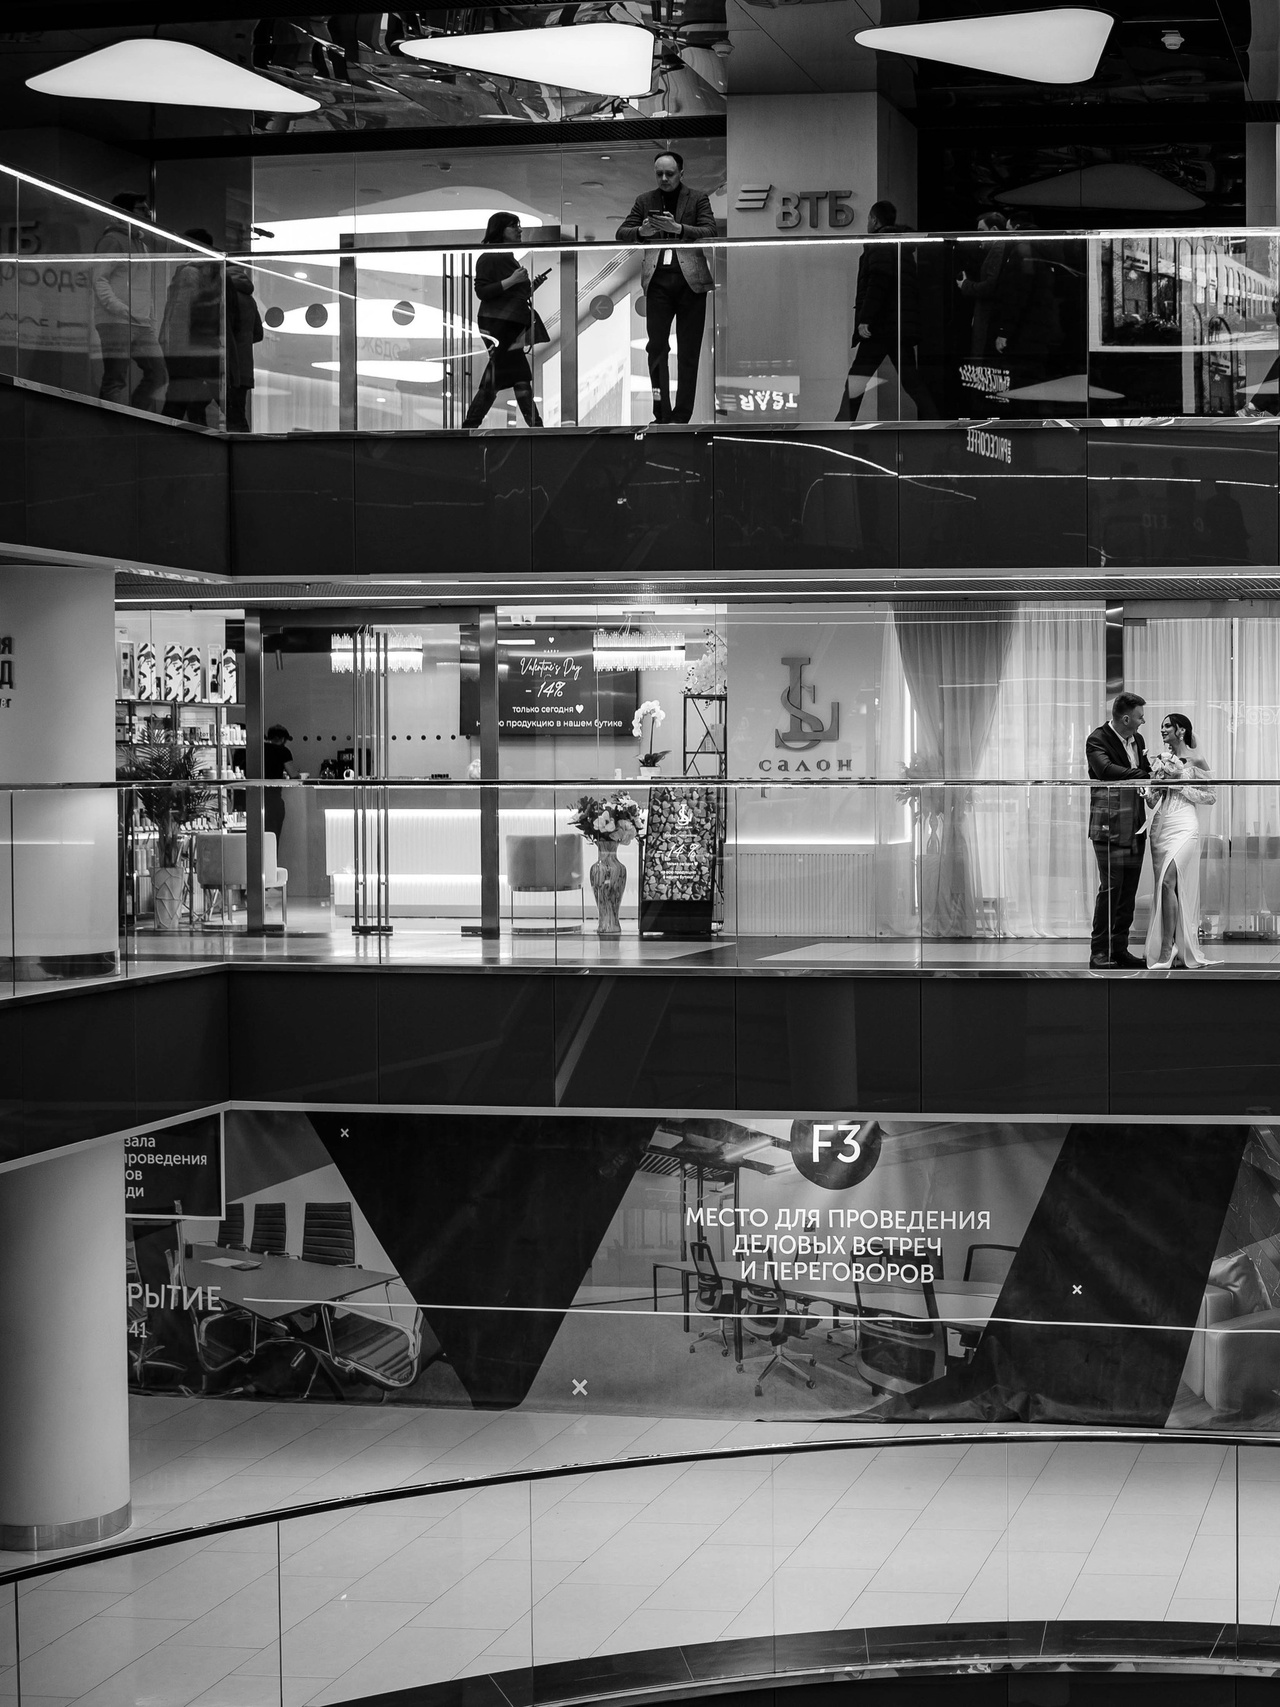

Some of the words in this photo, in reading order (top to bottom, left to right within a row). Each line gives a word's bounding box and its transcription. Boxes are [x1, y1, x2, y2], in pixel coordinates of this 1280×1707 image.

[776, 189, 855, 229] ВТБ
[520, 657, 561, 678] Valentine's
[563, 657, 583, 680] Day
[512, 705, 540, 714] только
[541, 706, 574, 715] сегодня
[506, 720, 554, 729] продукцию
[563, 720, 593, 728] нашем
[594, 718, 623, 729] бутике
[812, 1124, 861, 1164] F3
[124, 1153, 207, 1166] роведения
[686, 1207, 769, 1227] МЕСТО
[775, 1208, 820, 1230] ДЛЯ
[828, 1209, 991, 1233] ПРОВЕДЕНИЯ
[733, 1234, 847, 1256] ДЕЛОВЫХ
[853, 1236, 942, 1257] ВСТРЕЧ
[741, 1260, 756, 1280] И
[763, 1261, 935, 1283] ПЕРЕГОВОРОВ
[127, 1282, 222, 1311] РЫТИЕ
